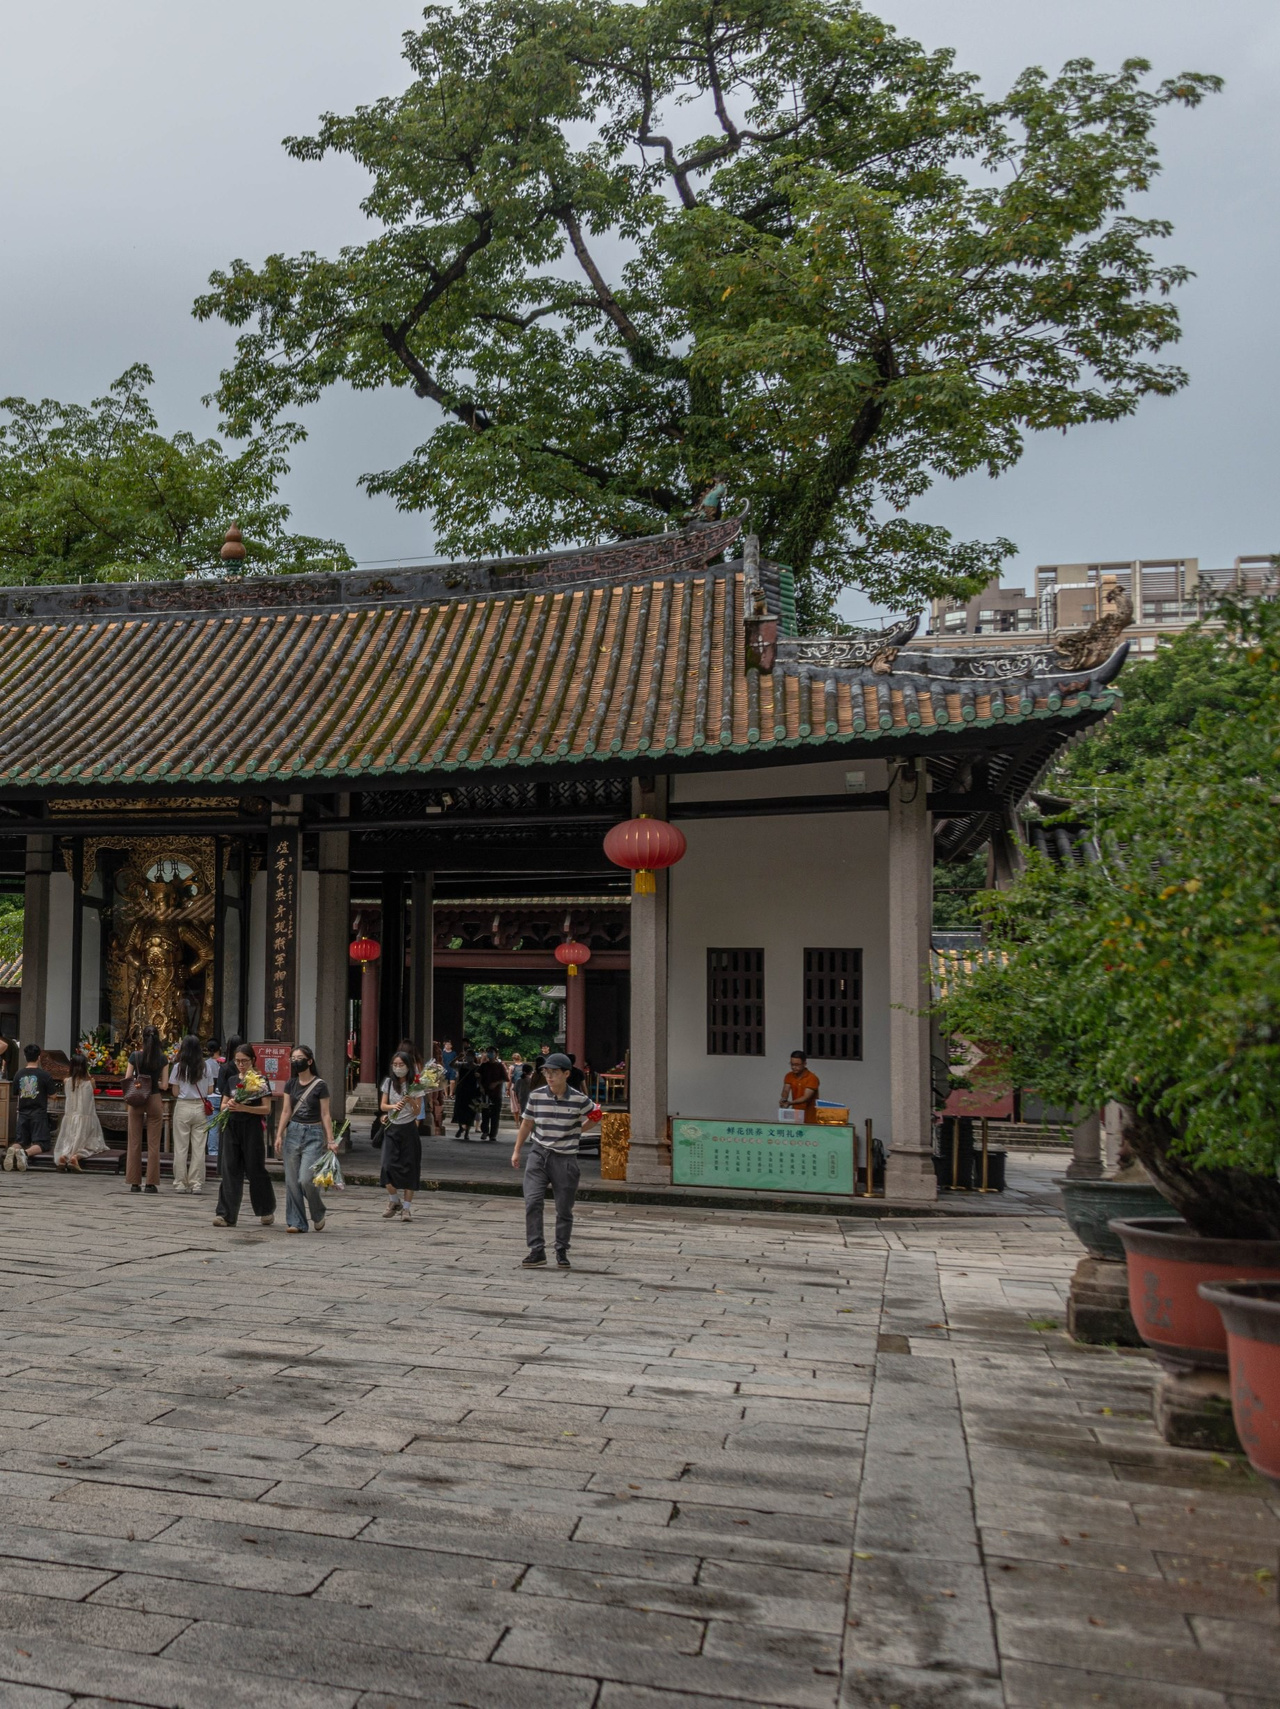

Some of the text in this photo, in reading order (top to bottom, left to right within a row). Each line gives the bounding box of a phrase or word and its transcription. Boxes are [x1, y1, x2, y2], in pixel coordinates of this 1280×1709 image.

[726, 1126, 804, 1138] 鲜花供养 文明礼佛
